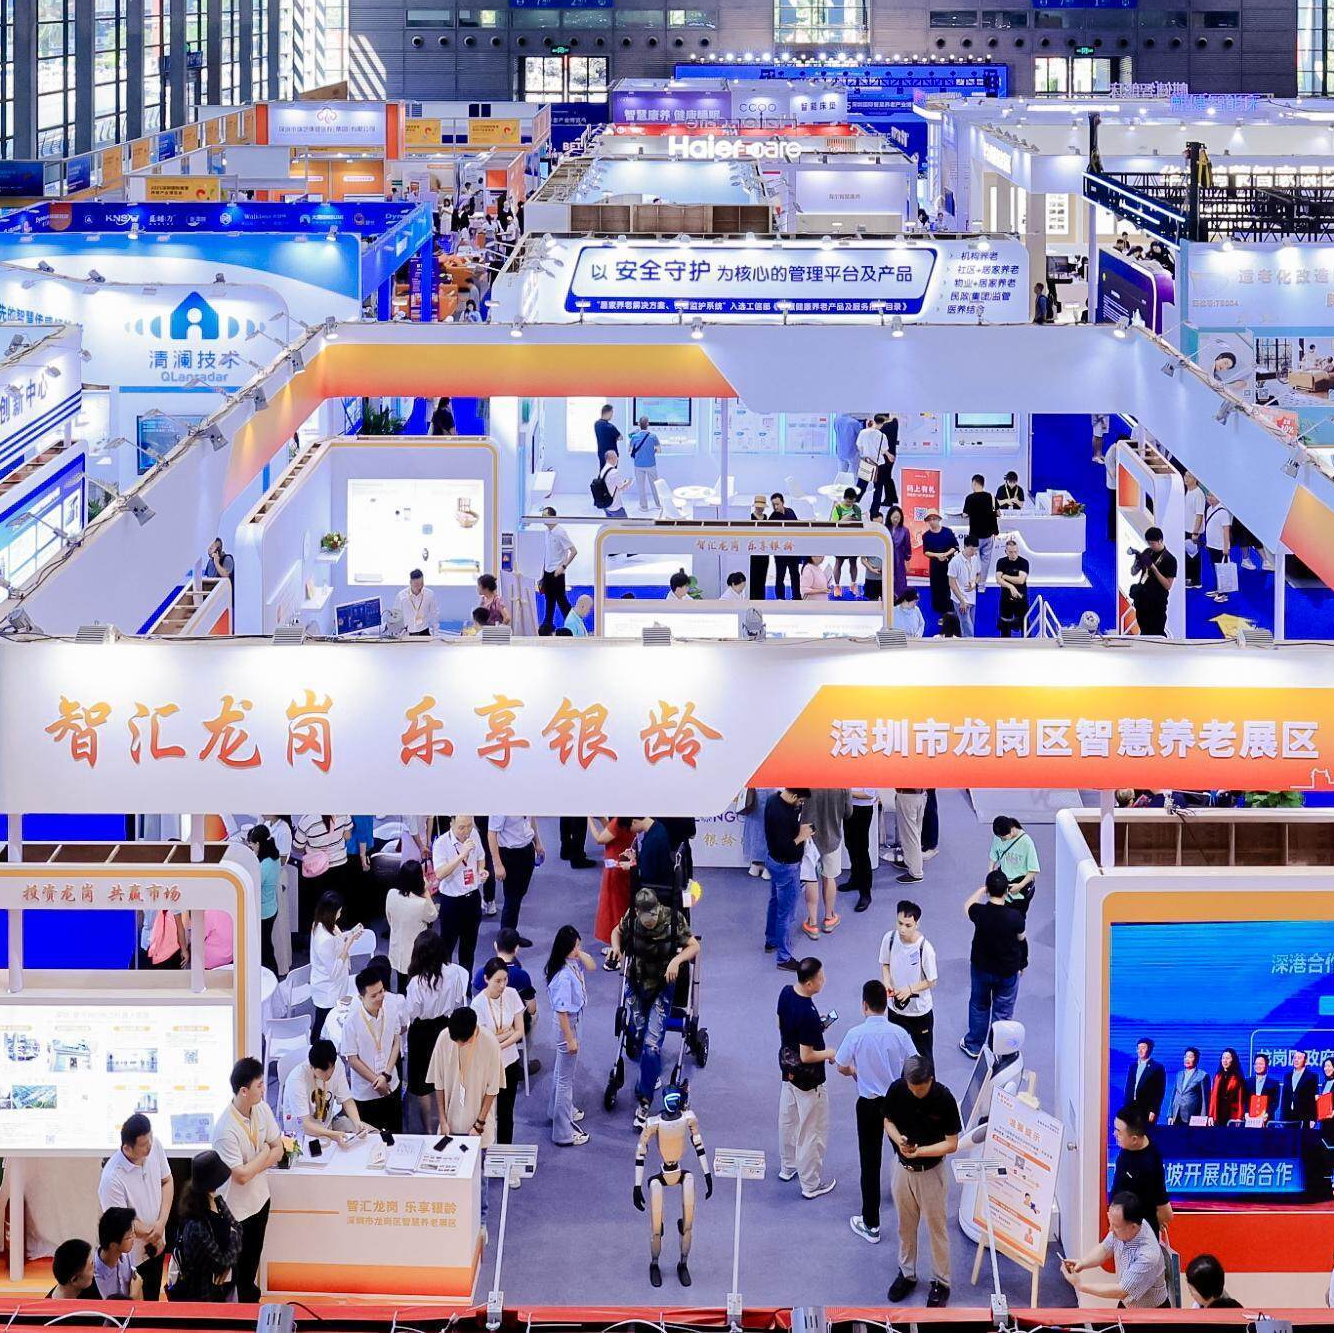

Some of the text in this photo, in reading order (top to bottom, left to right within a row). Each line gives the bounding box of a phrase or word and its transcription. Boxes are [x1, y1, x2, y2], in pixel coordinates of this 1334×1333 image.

[668, 133, 743, 159] Haier
[961, 252, 999, 261] 机构养老
[591, 259, 913, 283] 以 安全守护 为核心的管理平台及产品
[957, 265, 1020, 275] 社区+居家养老
[954, 278, 1017, 288] 物业+居家养老
[149, 349, 240, 370] 清澜技术
[46, 691, 724, 772] 智汇龙岗 乐享银龄
[829, 715, 1320, 761] 深圳市龙岗区智慧养老展区
[23, 883, 182, 903] 投资龙岗 共赢市场
[346, 1199, 457, 1214] 智汇龙岗 乐享银龄
[346, 1216, 457, 1228] 深圳市龙岗区智慧养老展区
